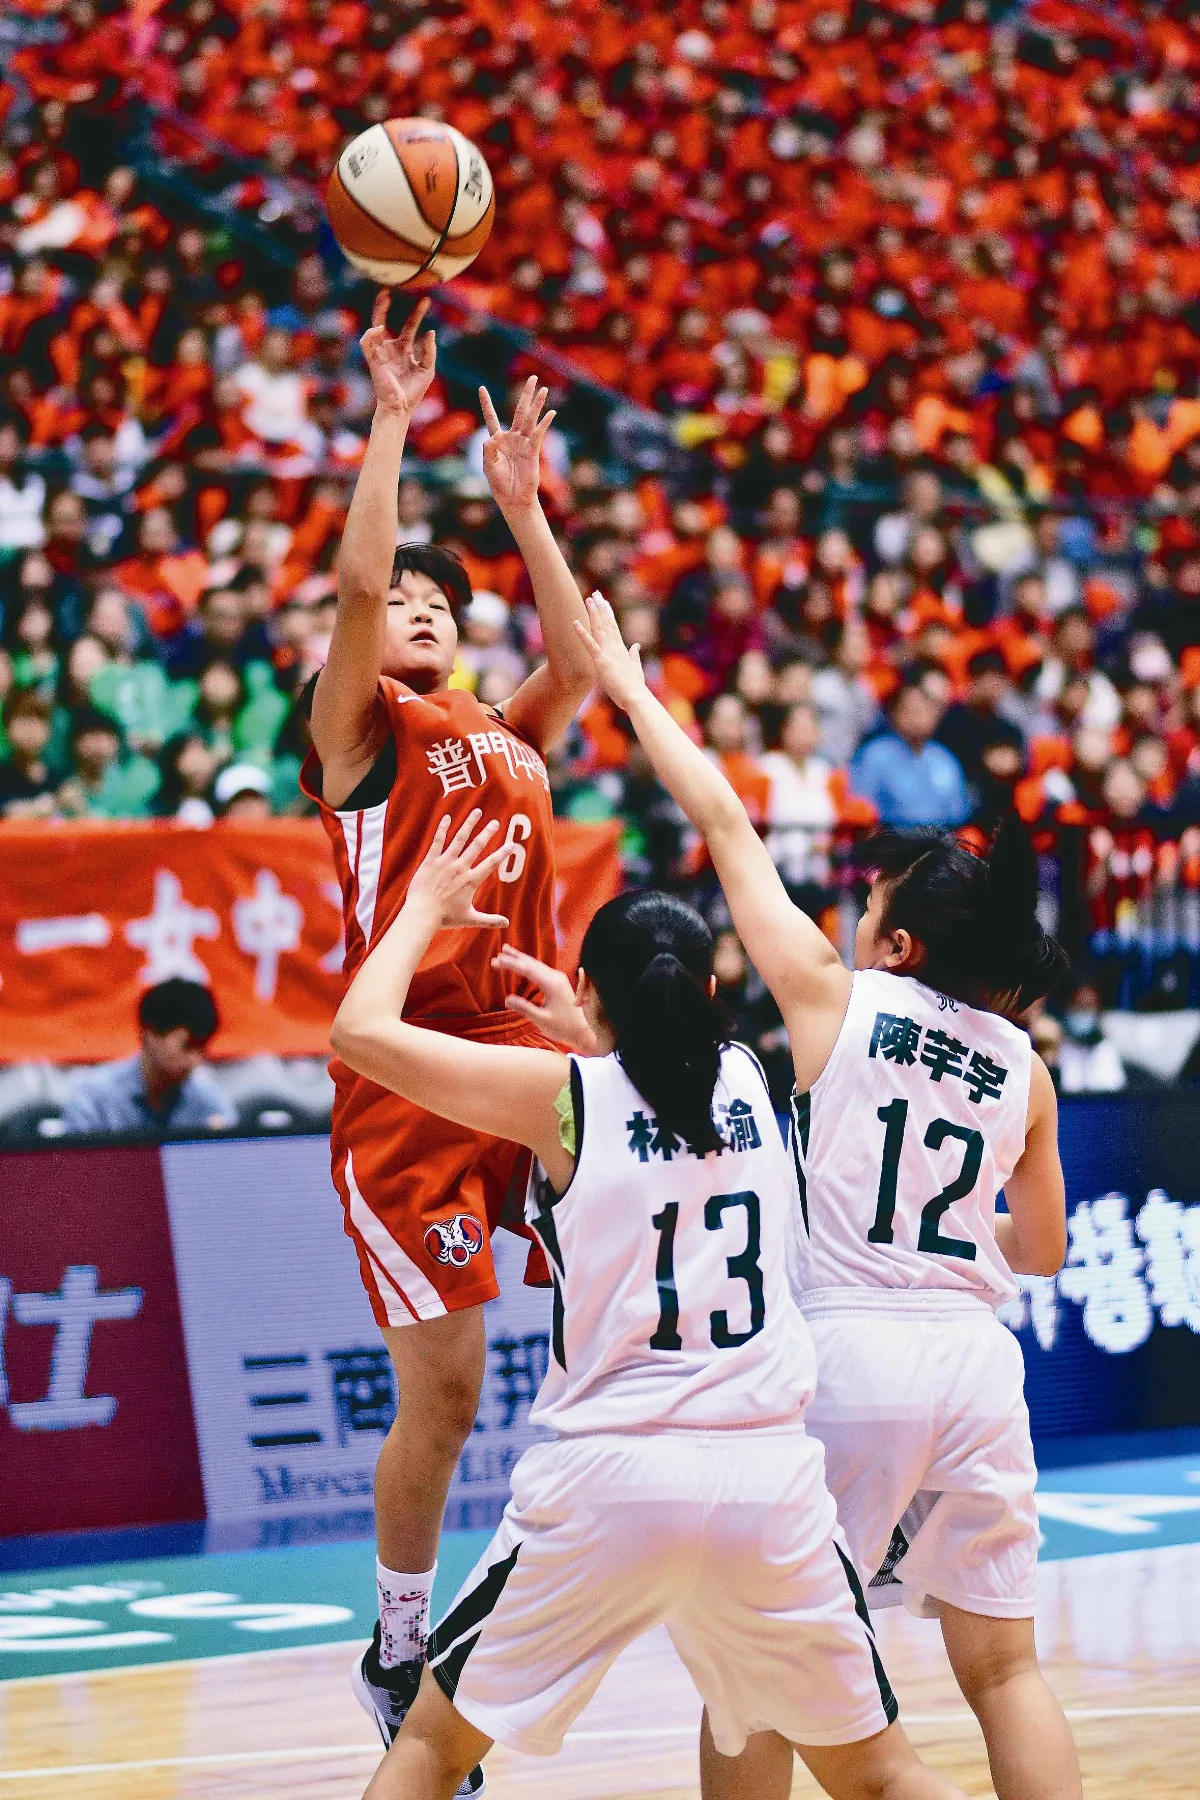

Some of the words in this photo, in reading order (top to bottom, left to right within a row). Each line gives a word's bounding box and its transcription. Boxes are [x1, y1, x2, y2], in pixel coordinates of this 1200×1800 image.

[498, 812, 532, 883] 6
[15, 866, 345, 1004] 一女中
[867, 1097, 985, 1262] 12
[649, 1190, 766, 1351] 13
